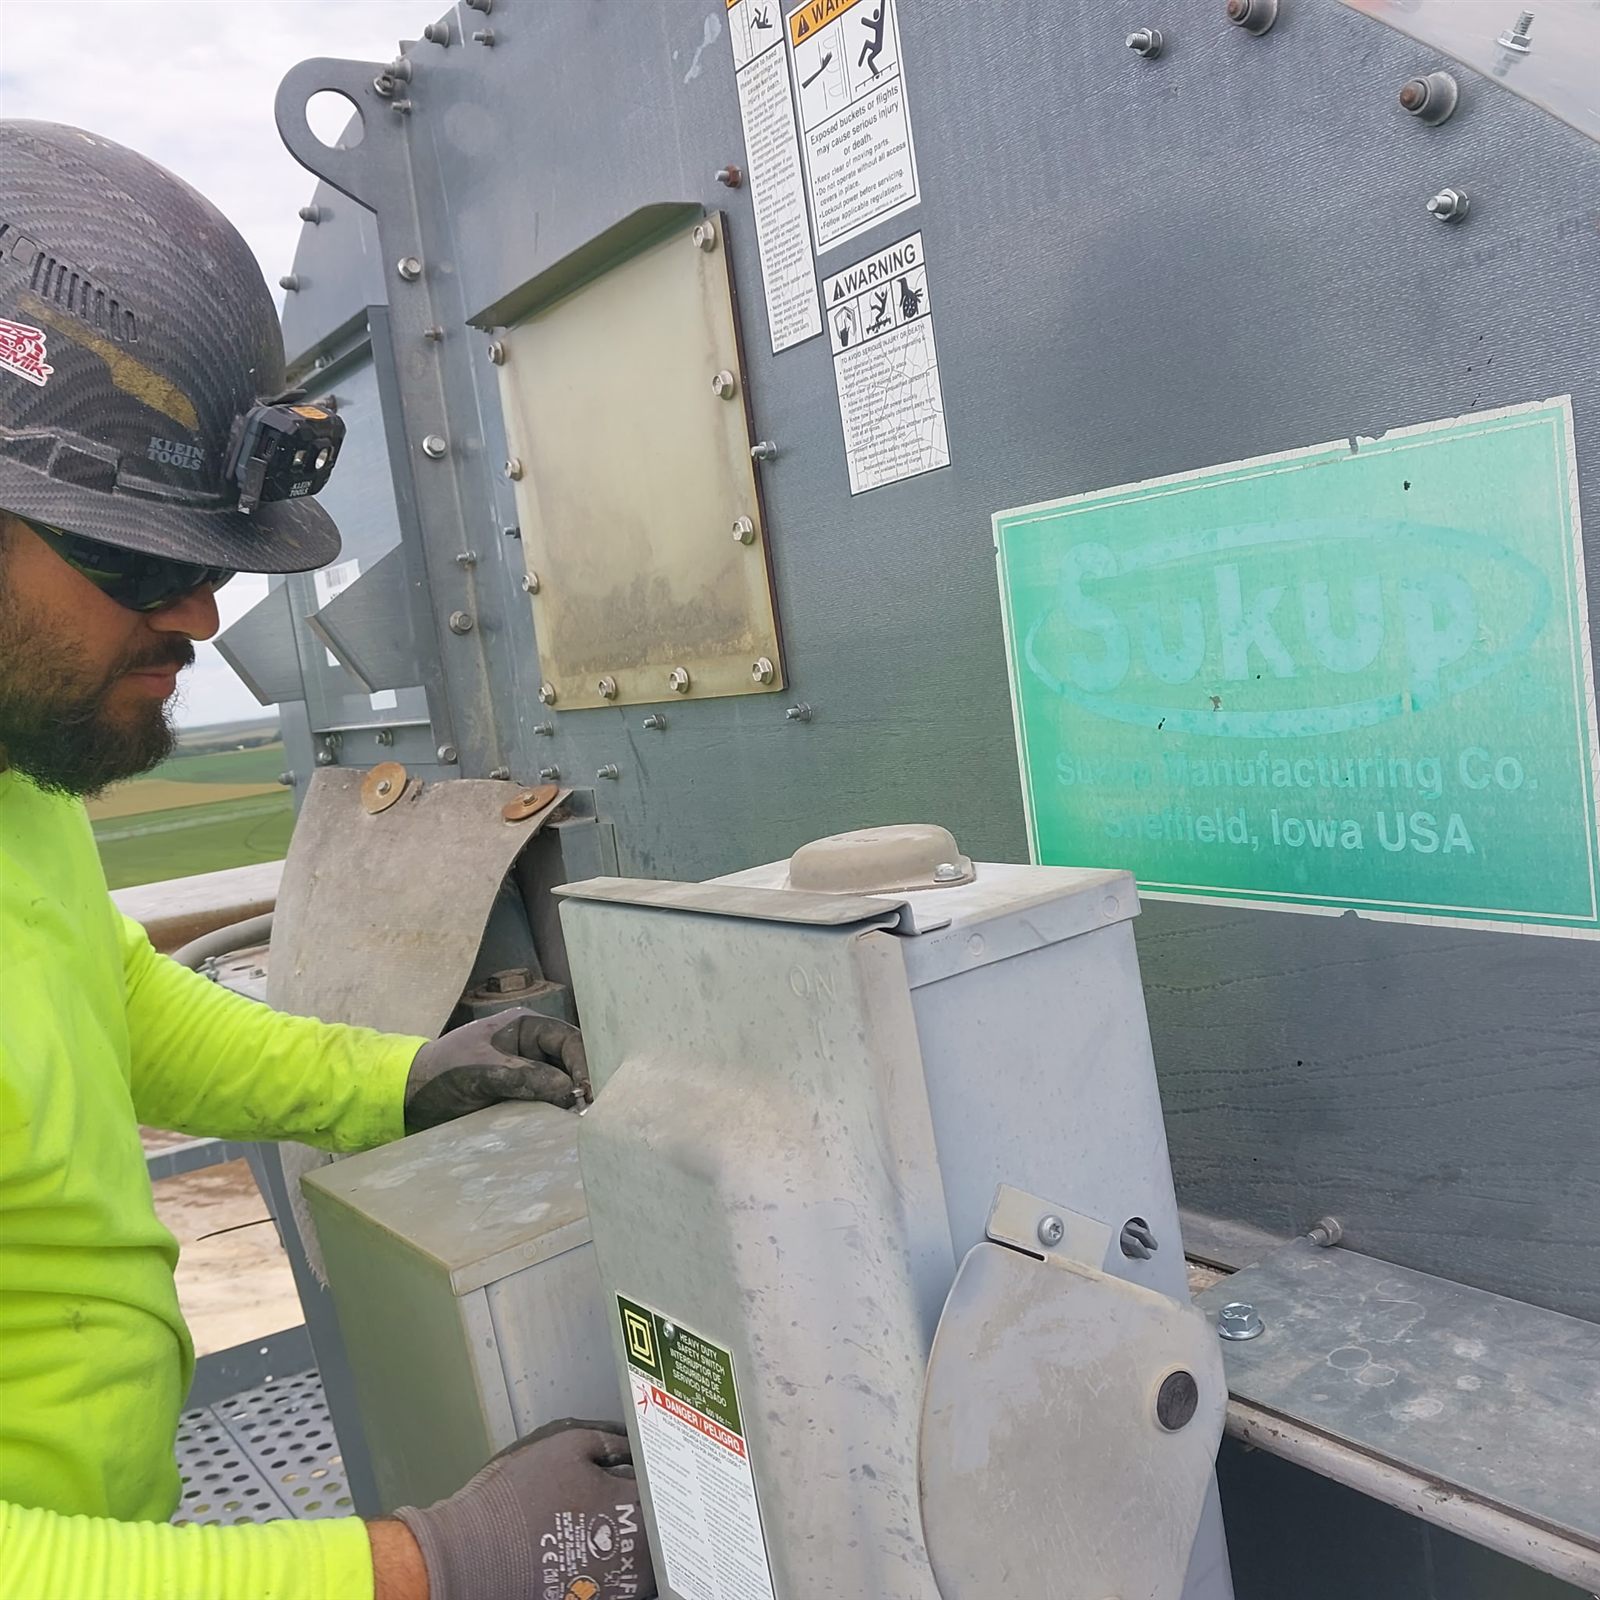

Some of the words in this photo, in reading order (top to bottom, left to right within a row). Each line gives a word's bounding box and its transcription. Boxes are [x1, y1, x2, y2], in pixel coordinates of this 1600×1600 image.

[810, 121, 838, 145] Exposed
[839, 106, 866, 127] buckets
[867, 100, 874, 110] or
[876, 85, 899, 105] flights
[816, 143, 830, 156] may
[831, 130, 850, 147] cause
[852, 114, 877, 135] serious
[878, 101, 899, 118] injury
[843, 145, 851, 156] or
[852, 133, 872, 150] death.
[826, 181, 836, 189] not
[836, 170, 856, 186] operate
[857, 157, 878, 173] without
[886, 141, 906, 157] access
[831, 164, 844, 176] clear
[845, 159, 851, 168] of
[852, 147, 873, 163] moving
[820, 193, 837, 206] covers
[841, 200, 869, 220] applicable
[842, 193, 858, 207] power
[859, 183, 876, 197] before
[844, 243, 916, 291] WARNING
[848, 351, 861, 361] AVOID
[862, 342, 882, 356] SERIOUS
[882, 334, 899, 346] INJURY
[899, 331, 907, 339] OR
[148, 448, 202, 471] TOOLS
[149, 436, 205, 461] KLEIN
[1056, 541, 1479, 710] Sukup
[1457, 746, 1540, 790] Co.
[1271, 808, 1363, 850] Iowa
[1376, 810, 1476, 855] USA
[676, 1342, 699, 1360] SAFETY
[700, 1355, 725, 1375] SWITCH
[679, 1334, 699, 1350] HEAVY
[700, 1345, 717, 1360] DUTY
[670, 1349, 711, 1377] INTERRUPTOR
[712, 1372, 722, 1384] DE
[675, 1361, 710, 1387] SEGURIDAD
[710, 1381, 720, 1393] DE
[672, 1369, 700, 1391] SERVICIO
[701, 1386, 727, 1406] PESADO
[665, 1398, 698, 1426] DANGER
[703, 1421, 740, 1451] PELIGRO
